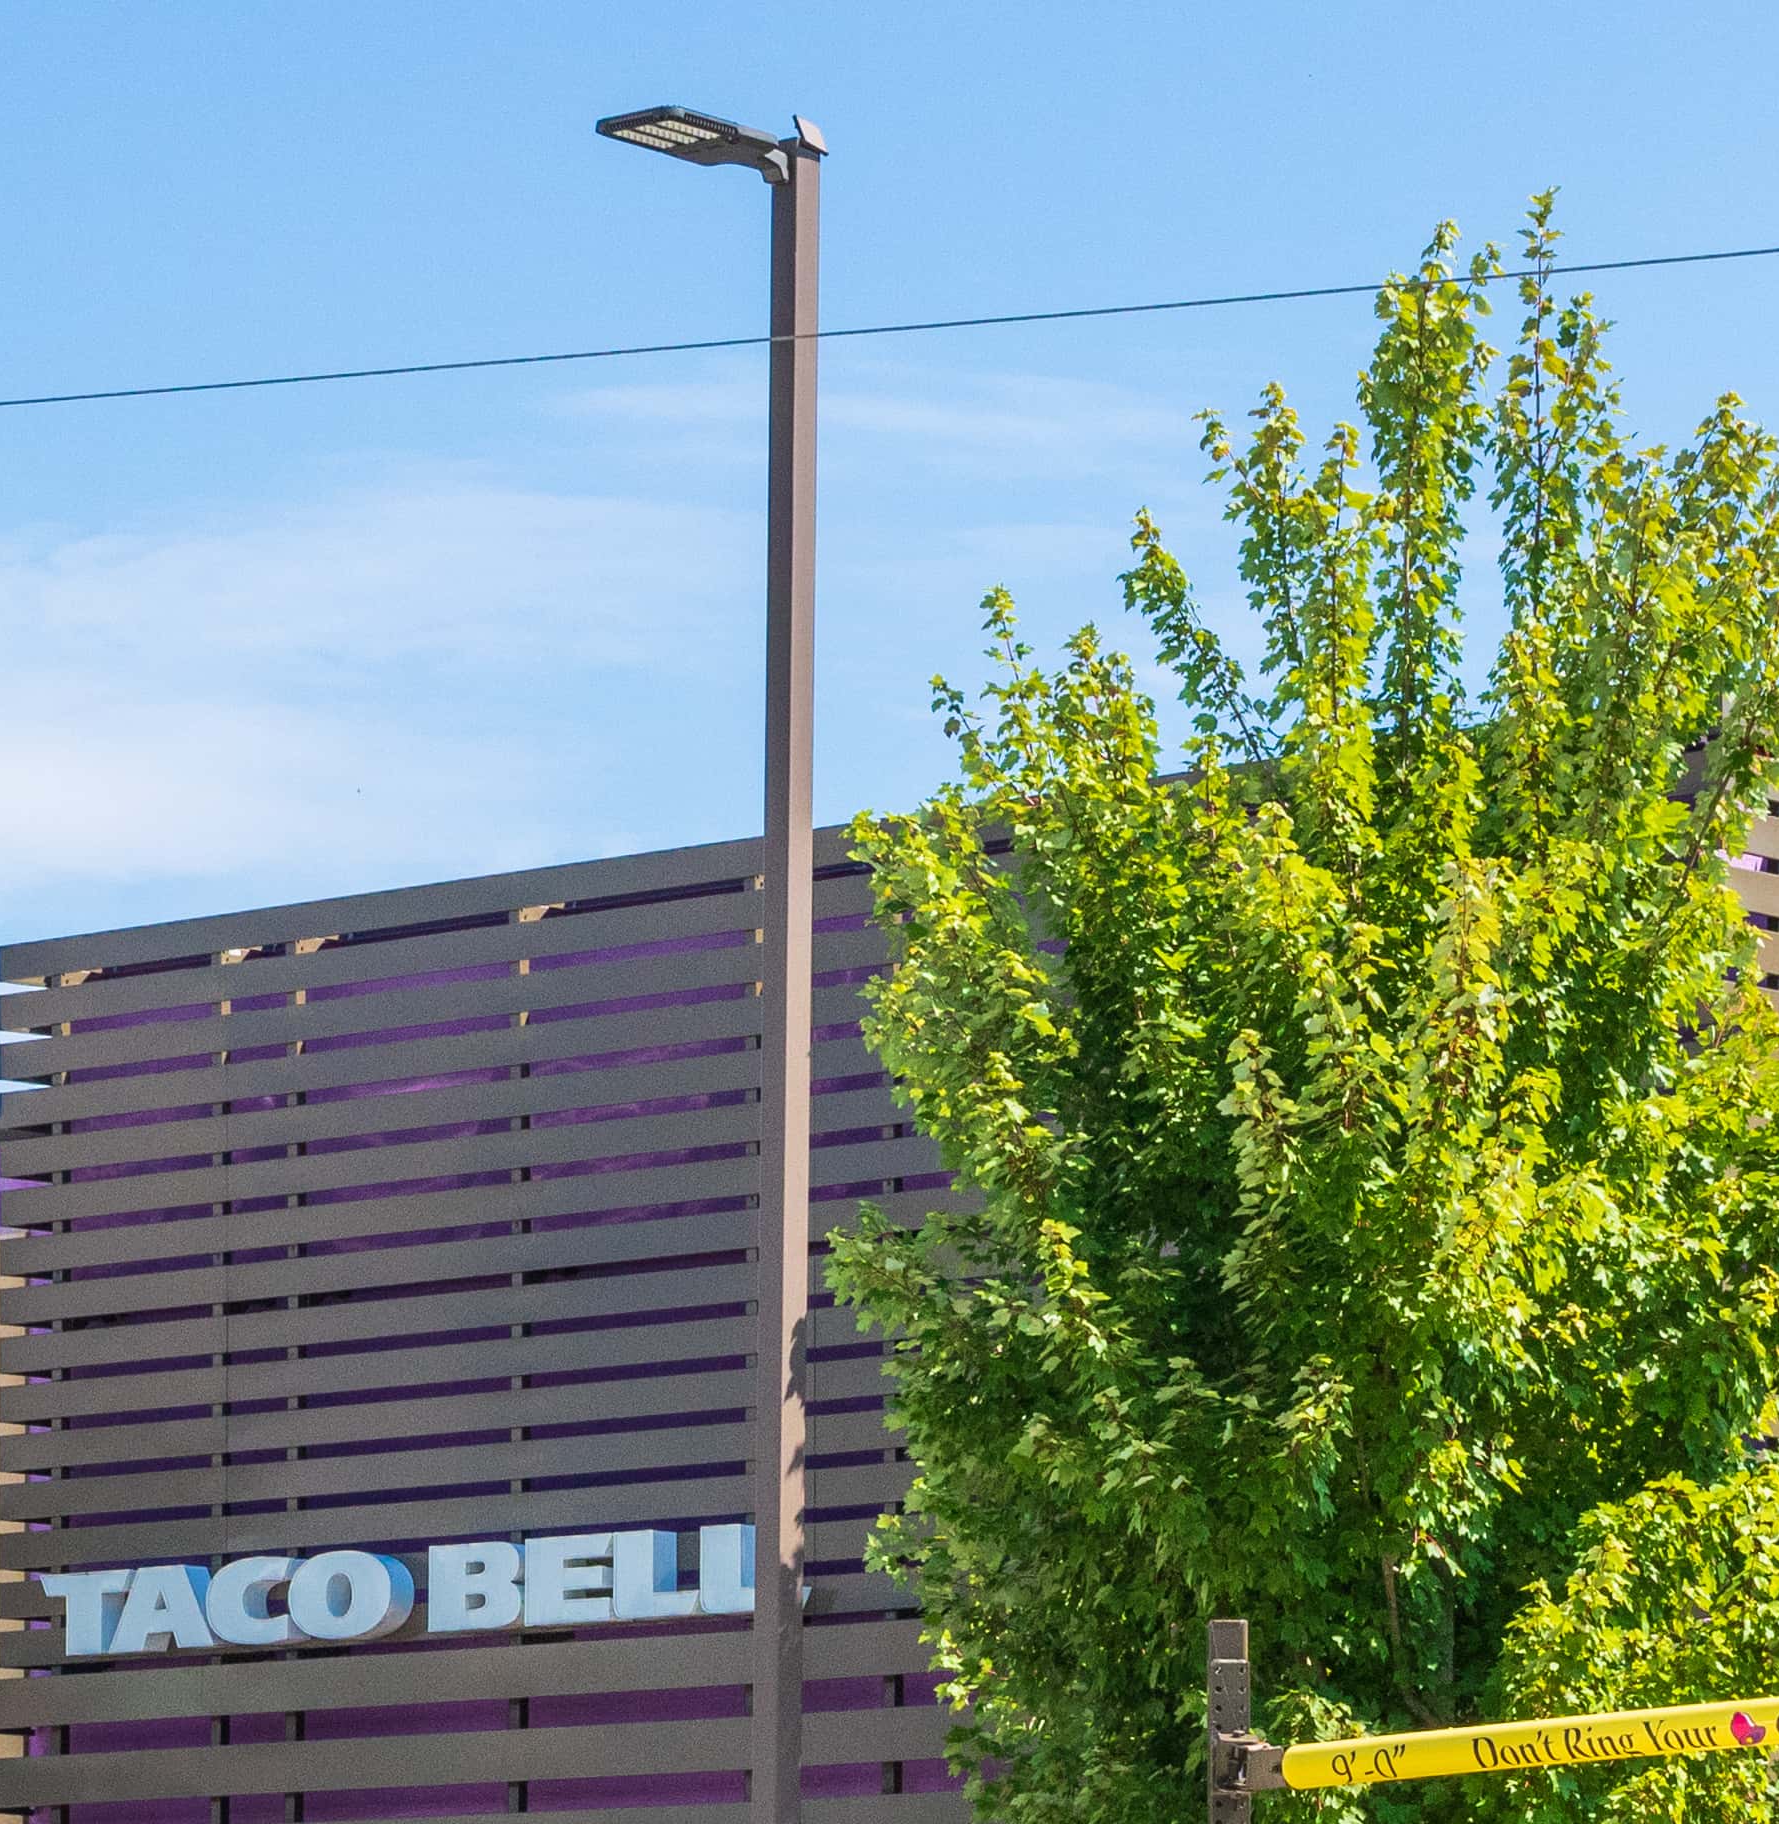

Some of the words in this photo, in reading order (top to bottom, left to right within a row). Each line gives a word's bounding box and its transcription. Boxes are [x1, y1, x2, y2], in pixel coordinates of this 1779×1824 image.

[40, 1550, 414, 1656] TACO
[427, 1523, 810, 1633] BELL
[1472, 1730, 1560, 1769] Don't
[1563, 1725, 1645, 1760] Ring
[1642, 1719, 1718, 1751] Your
